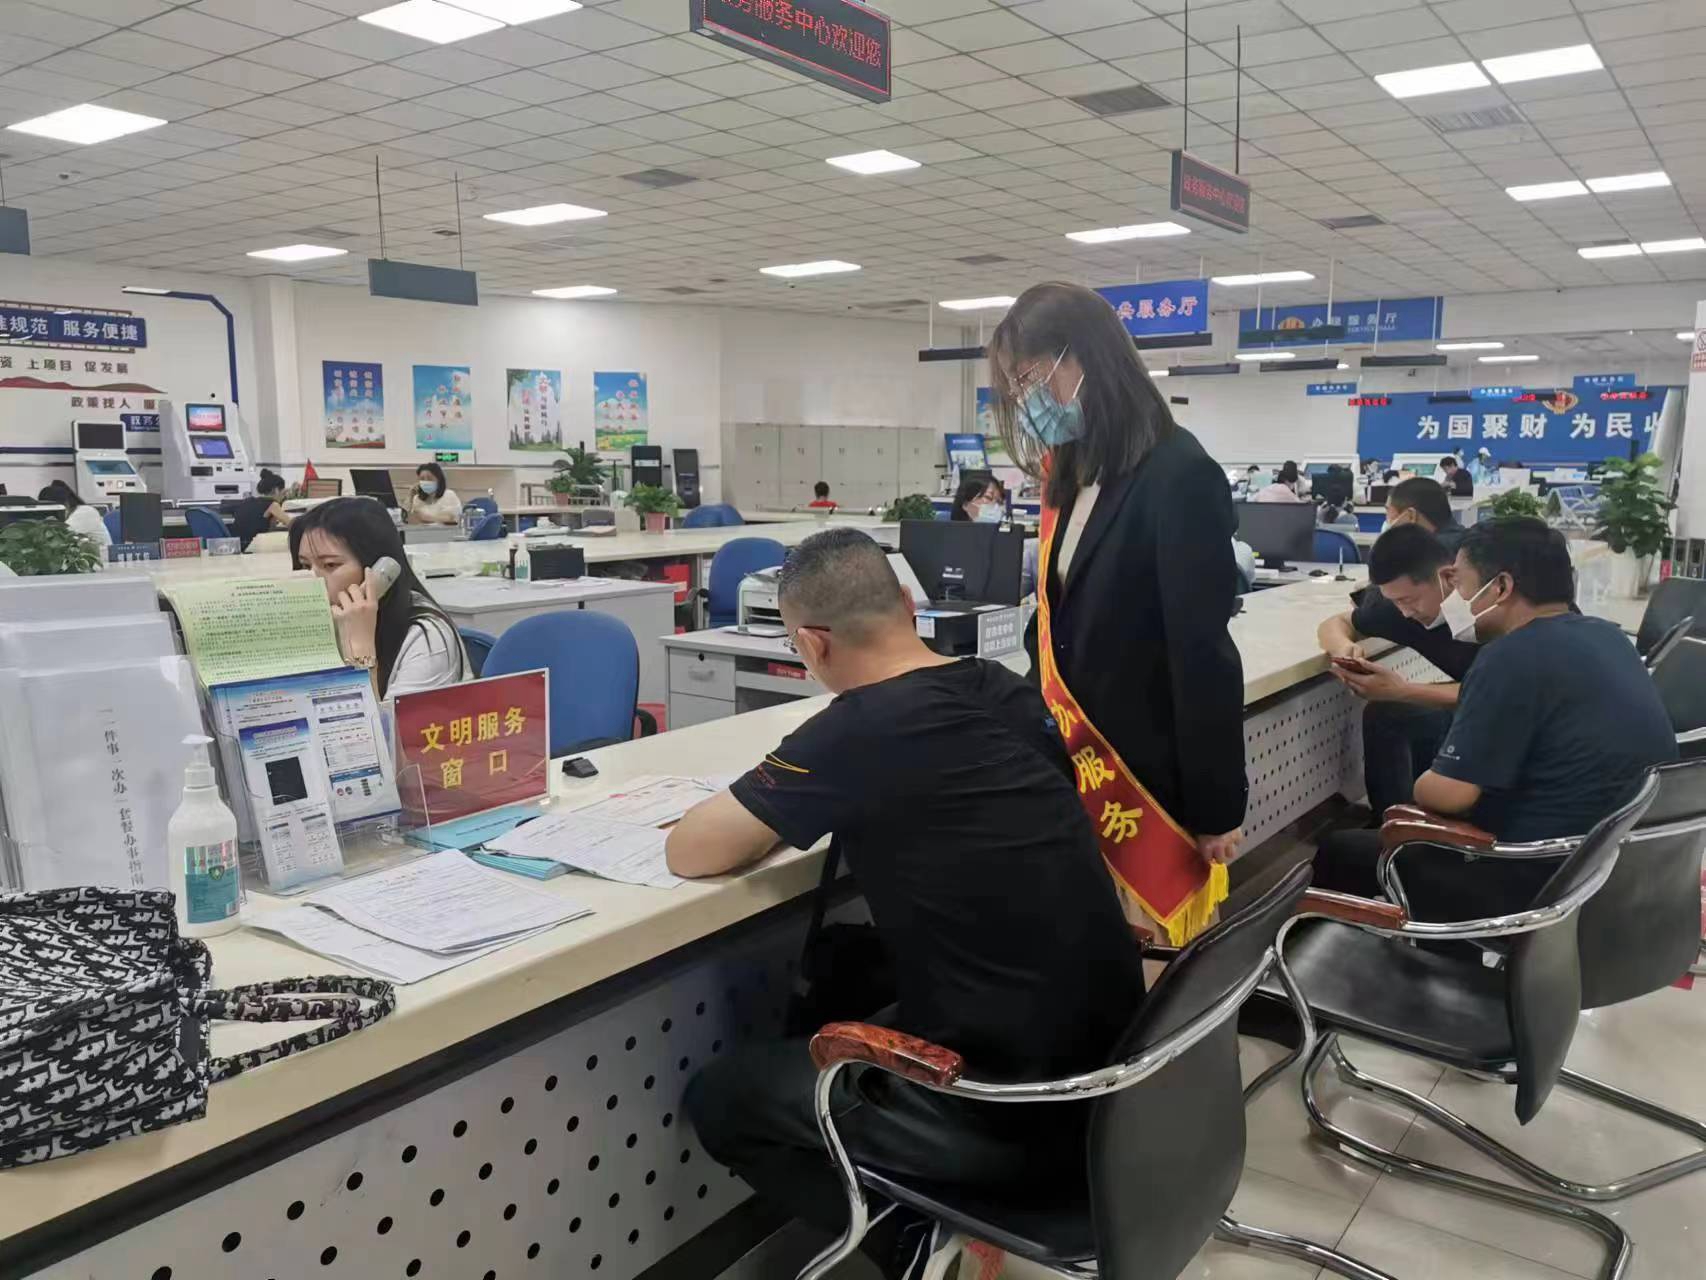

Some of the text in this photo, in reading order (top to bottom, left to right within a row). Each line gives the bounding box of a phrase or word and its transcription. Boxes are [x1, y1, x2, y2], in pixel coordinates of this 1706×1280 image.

[63, 319, 138, 341] 服务便捷
[26, 358, 72, 371] 上项目
[1416, 412, 1548, 440] 为国聚财
[420, 706, 527, 754] 文明服务
[440, 749, 508, 789] 窗口
